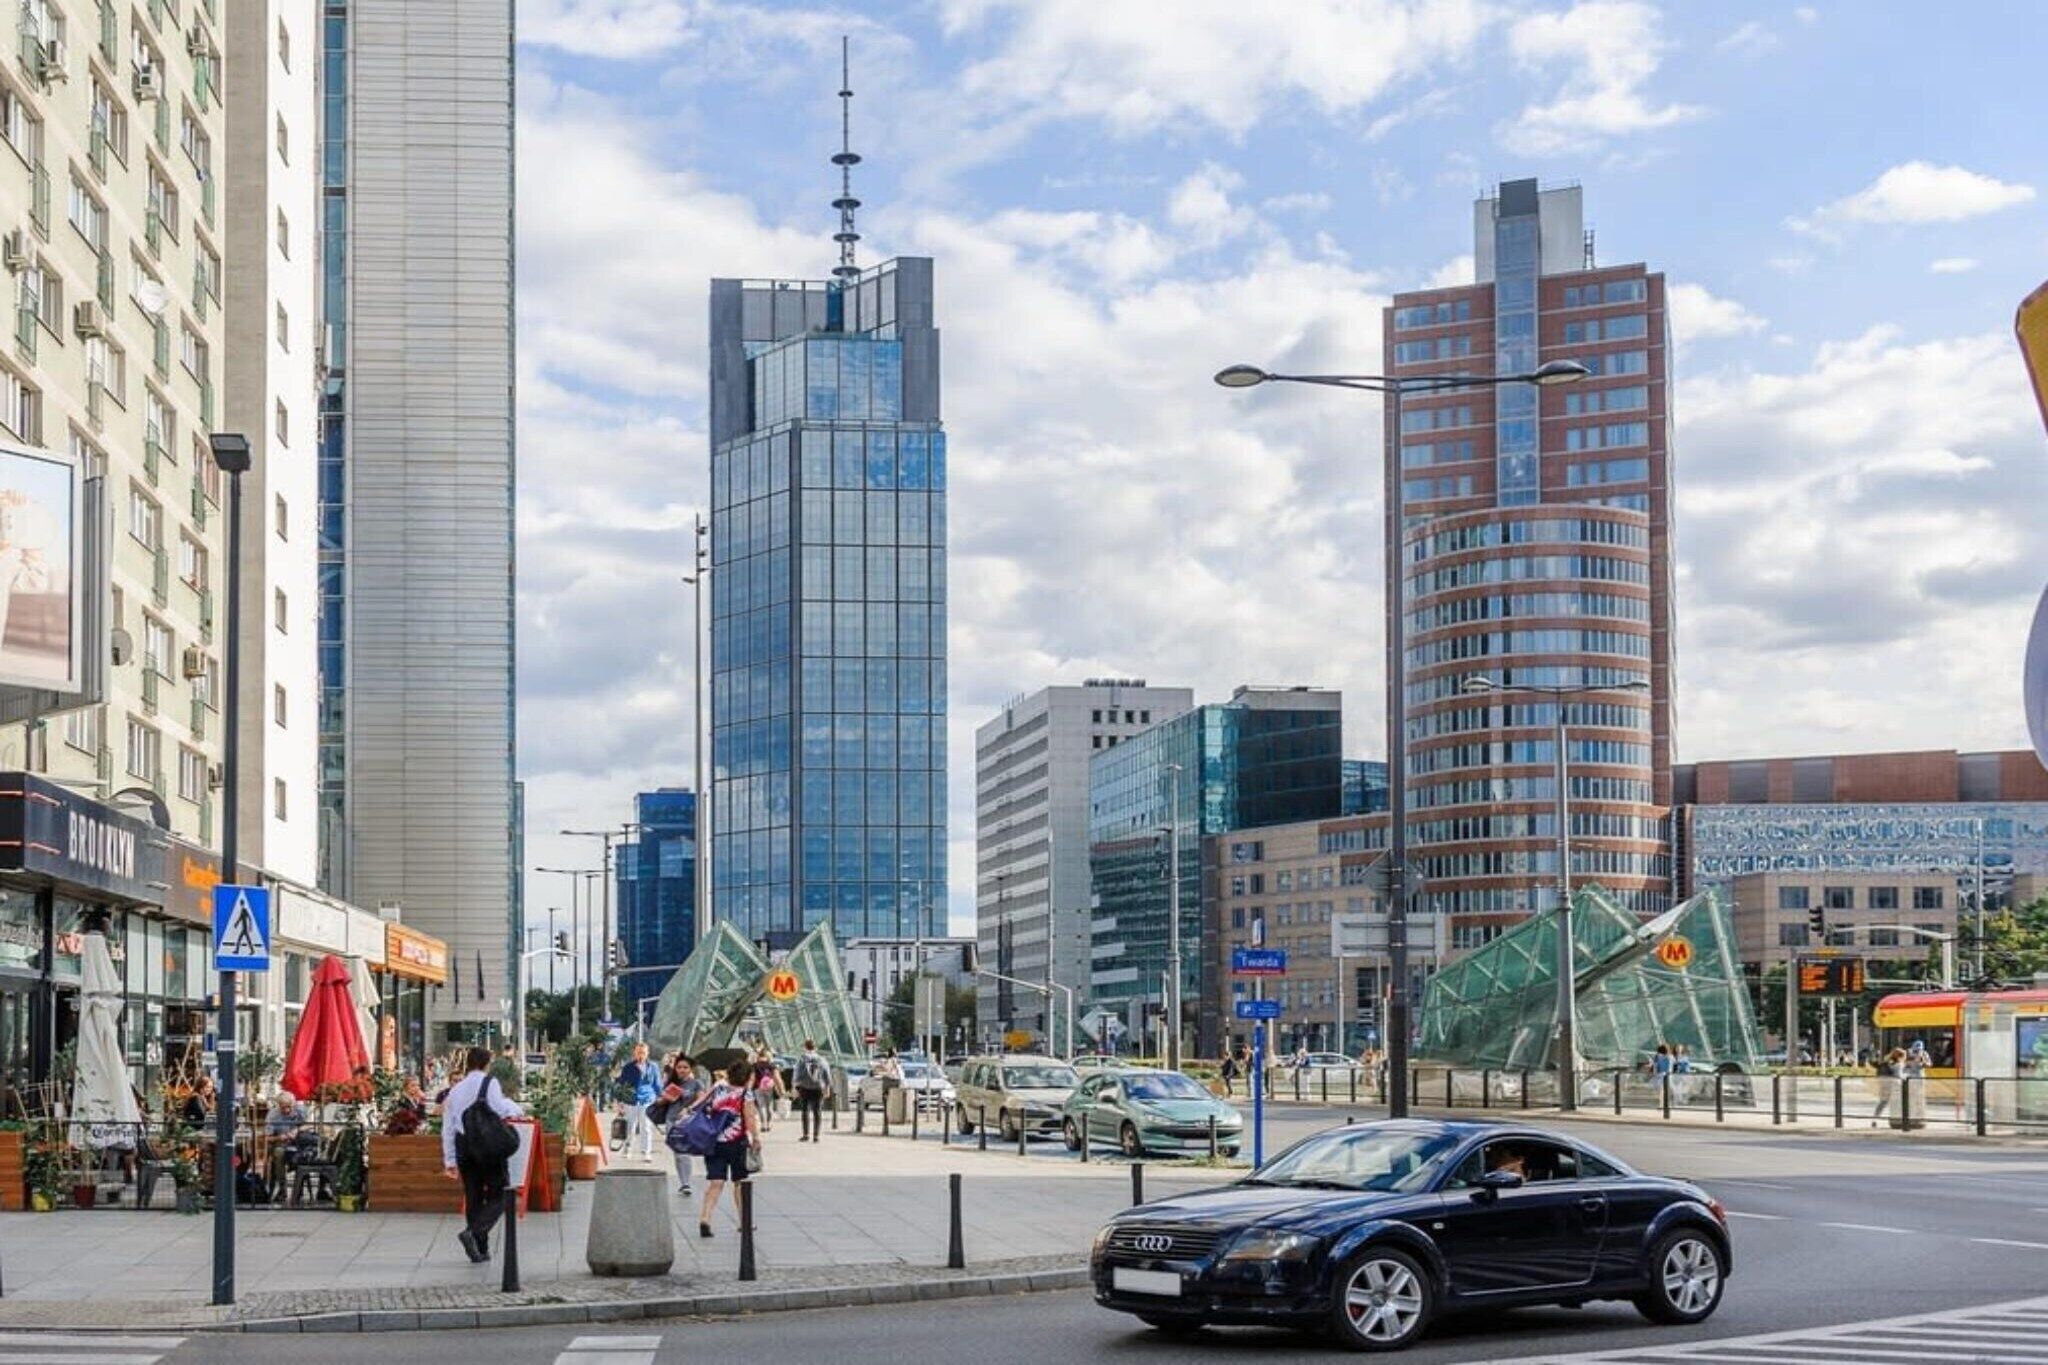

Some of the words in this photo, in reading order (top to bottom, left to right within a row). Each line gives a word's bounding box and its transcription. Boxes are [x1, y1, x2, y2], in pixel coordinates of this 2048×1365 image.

[68, 810, 135, 879] BROOKLYN
[1666, 943, 1687, 960] M
[1241, 956, 1279, 967] Twarda
[774, 976, 796, 994] M
